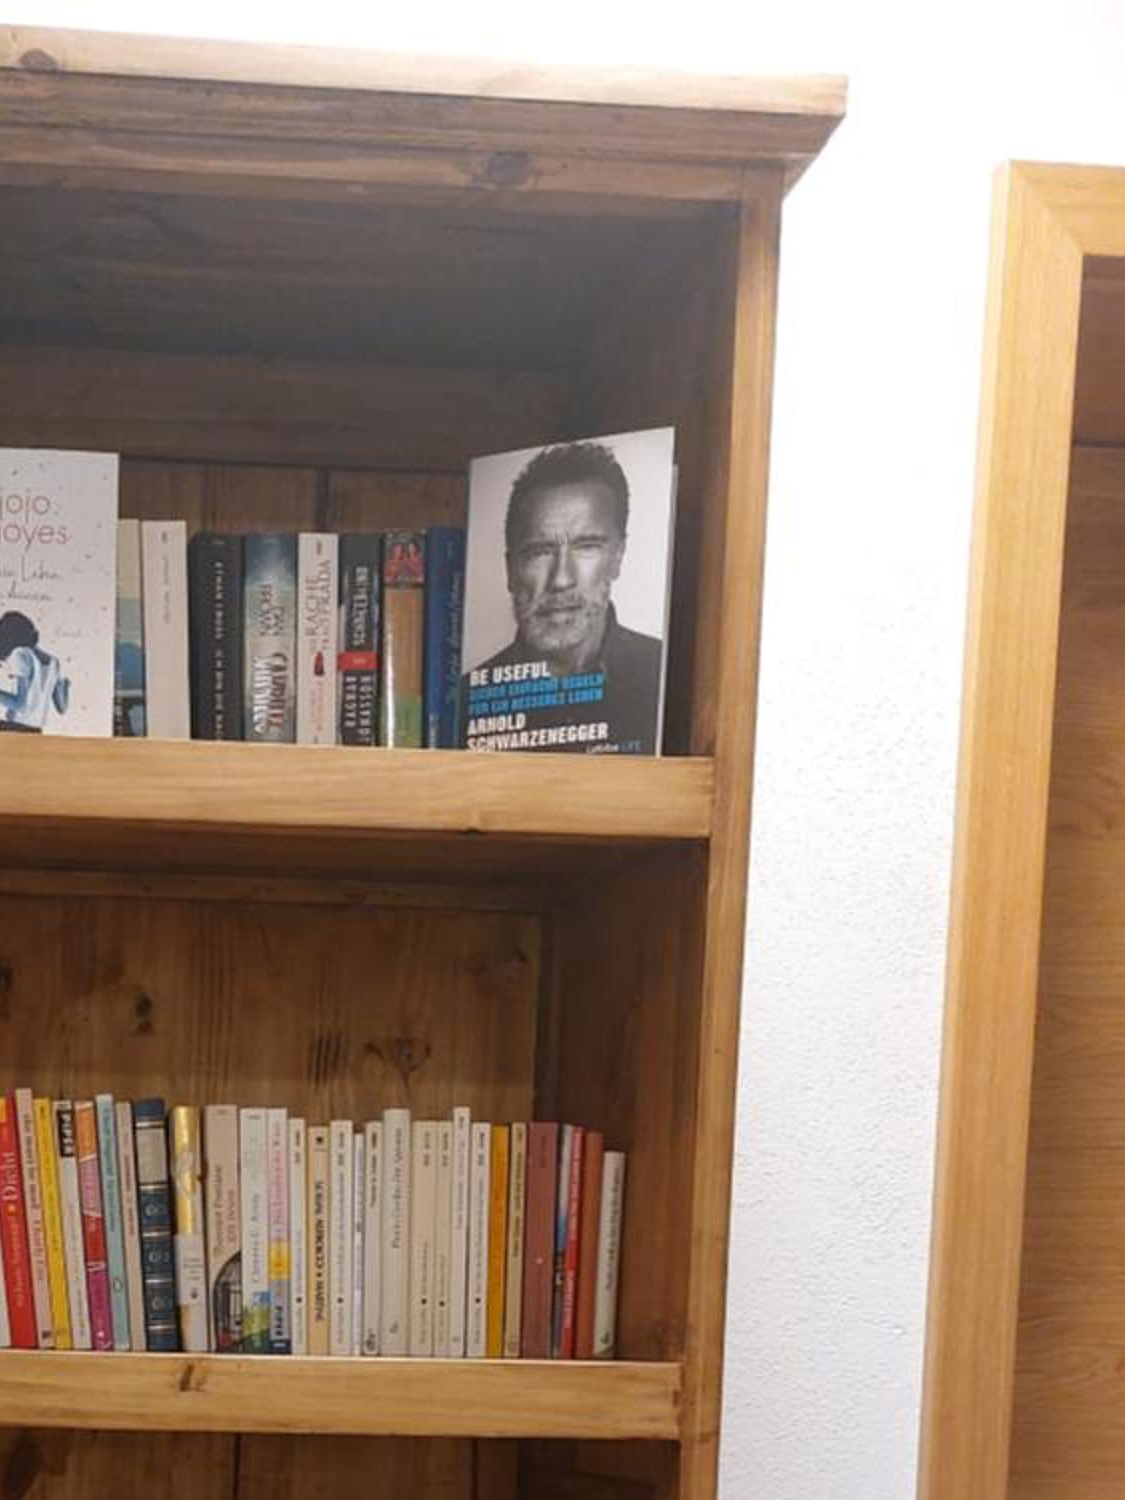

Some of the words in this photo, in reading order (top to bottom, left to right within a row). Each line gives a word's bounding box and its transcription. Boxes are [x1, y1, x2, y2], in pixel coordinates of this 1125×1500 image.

[470, 669, 489, 687] BE
[493, 661, 552, 683] USEFUL
[466, 722, 609, 752] SCHWARZENEGGER
[467, 712, 526, 736] ARNOLD
